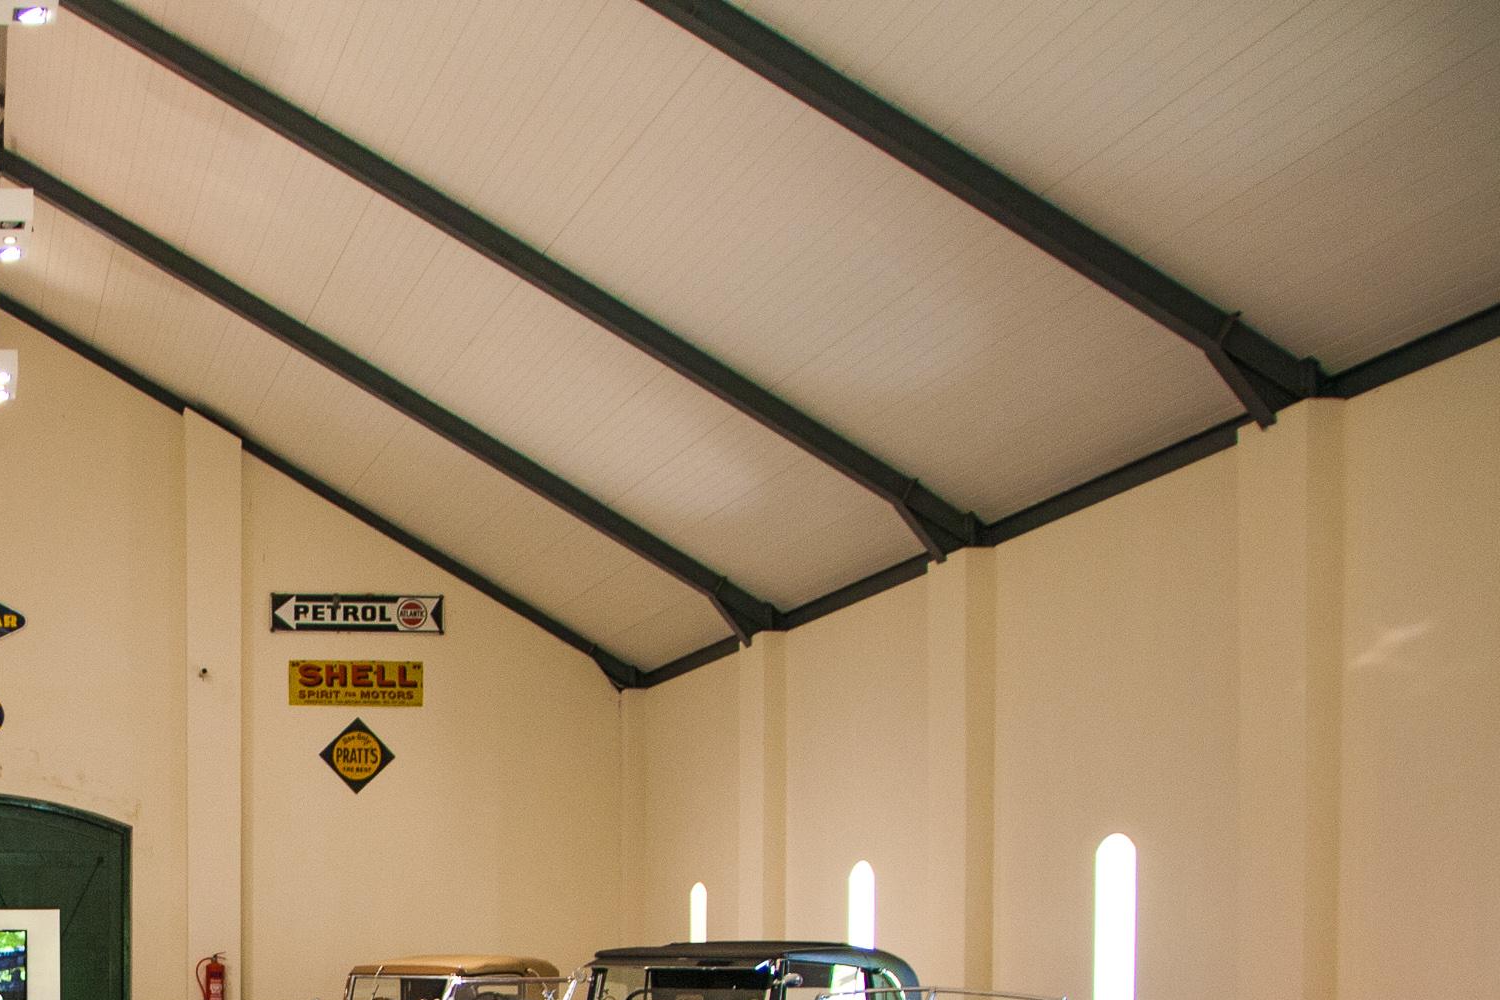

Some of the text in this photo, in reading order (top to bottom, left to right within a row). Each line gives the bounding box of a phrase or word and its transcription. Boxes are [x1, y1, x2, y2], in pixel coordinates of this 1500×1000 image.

[294, 604, 391, 621] PETROL
[299, 690, 340, 700] SPIRIT
[360, 691, 414, 700] MOTORS
